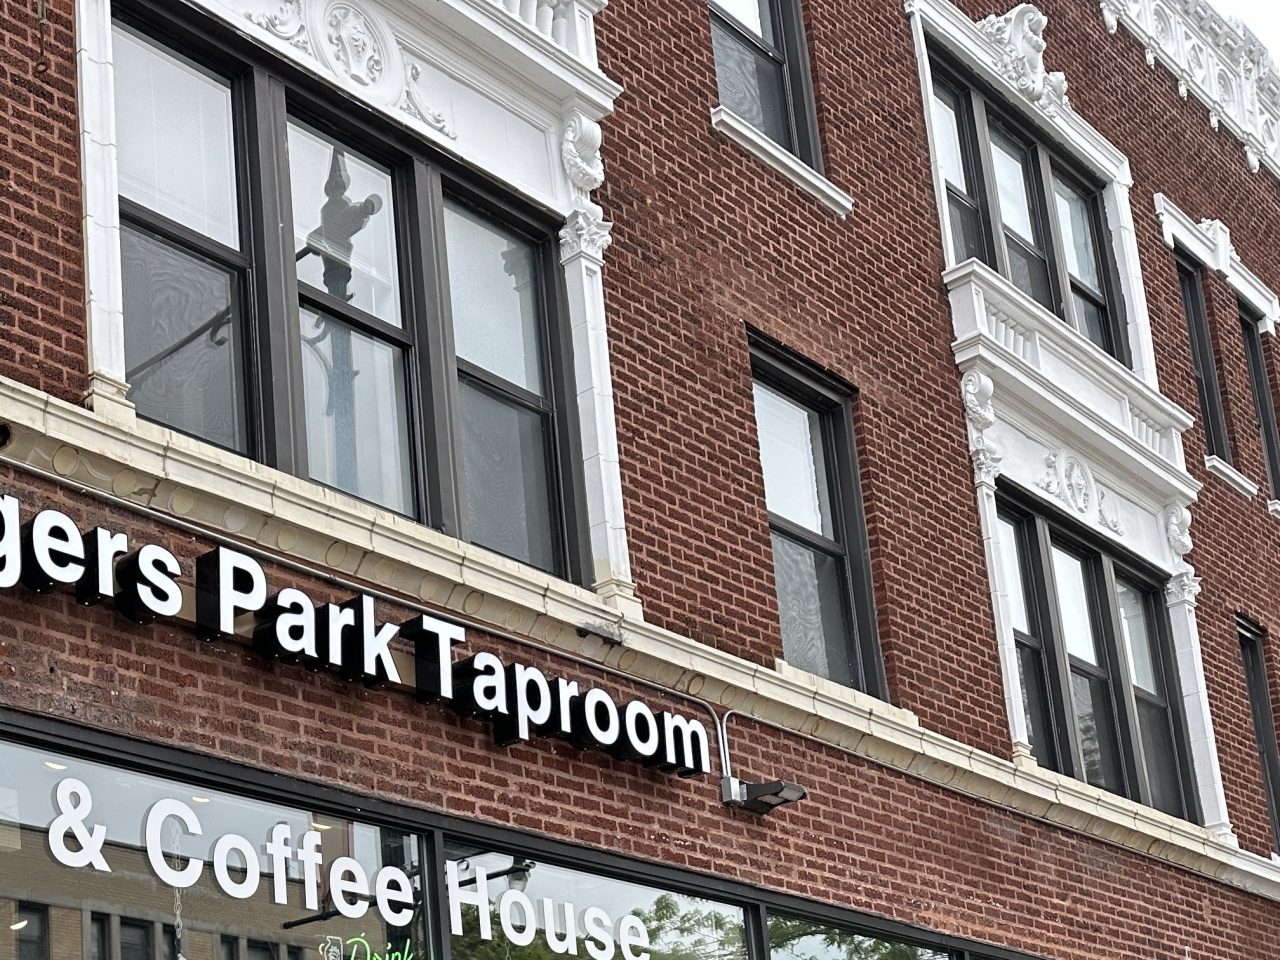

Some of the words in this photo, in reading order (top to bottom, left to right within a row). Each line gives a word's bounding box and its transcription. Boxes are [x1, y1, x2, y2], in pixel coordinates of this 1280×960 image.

[219, 546, 402, 684] Park
[422, 616, 711, 774] Taproom
[47, 777, 112, 873] &
[145, 798, 415, 928] Coffee
